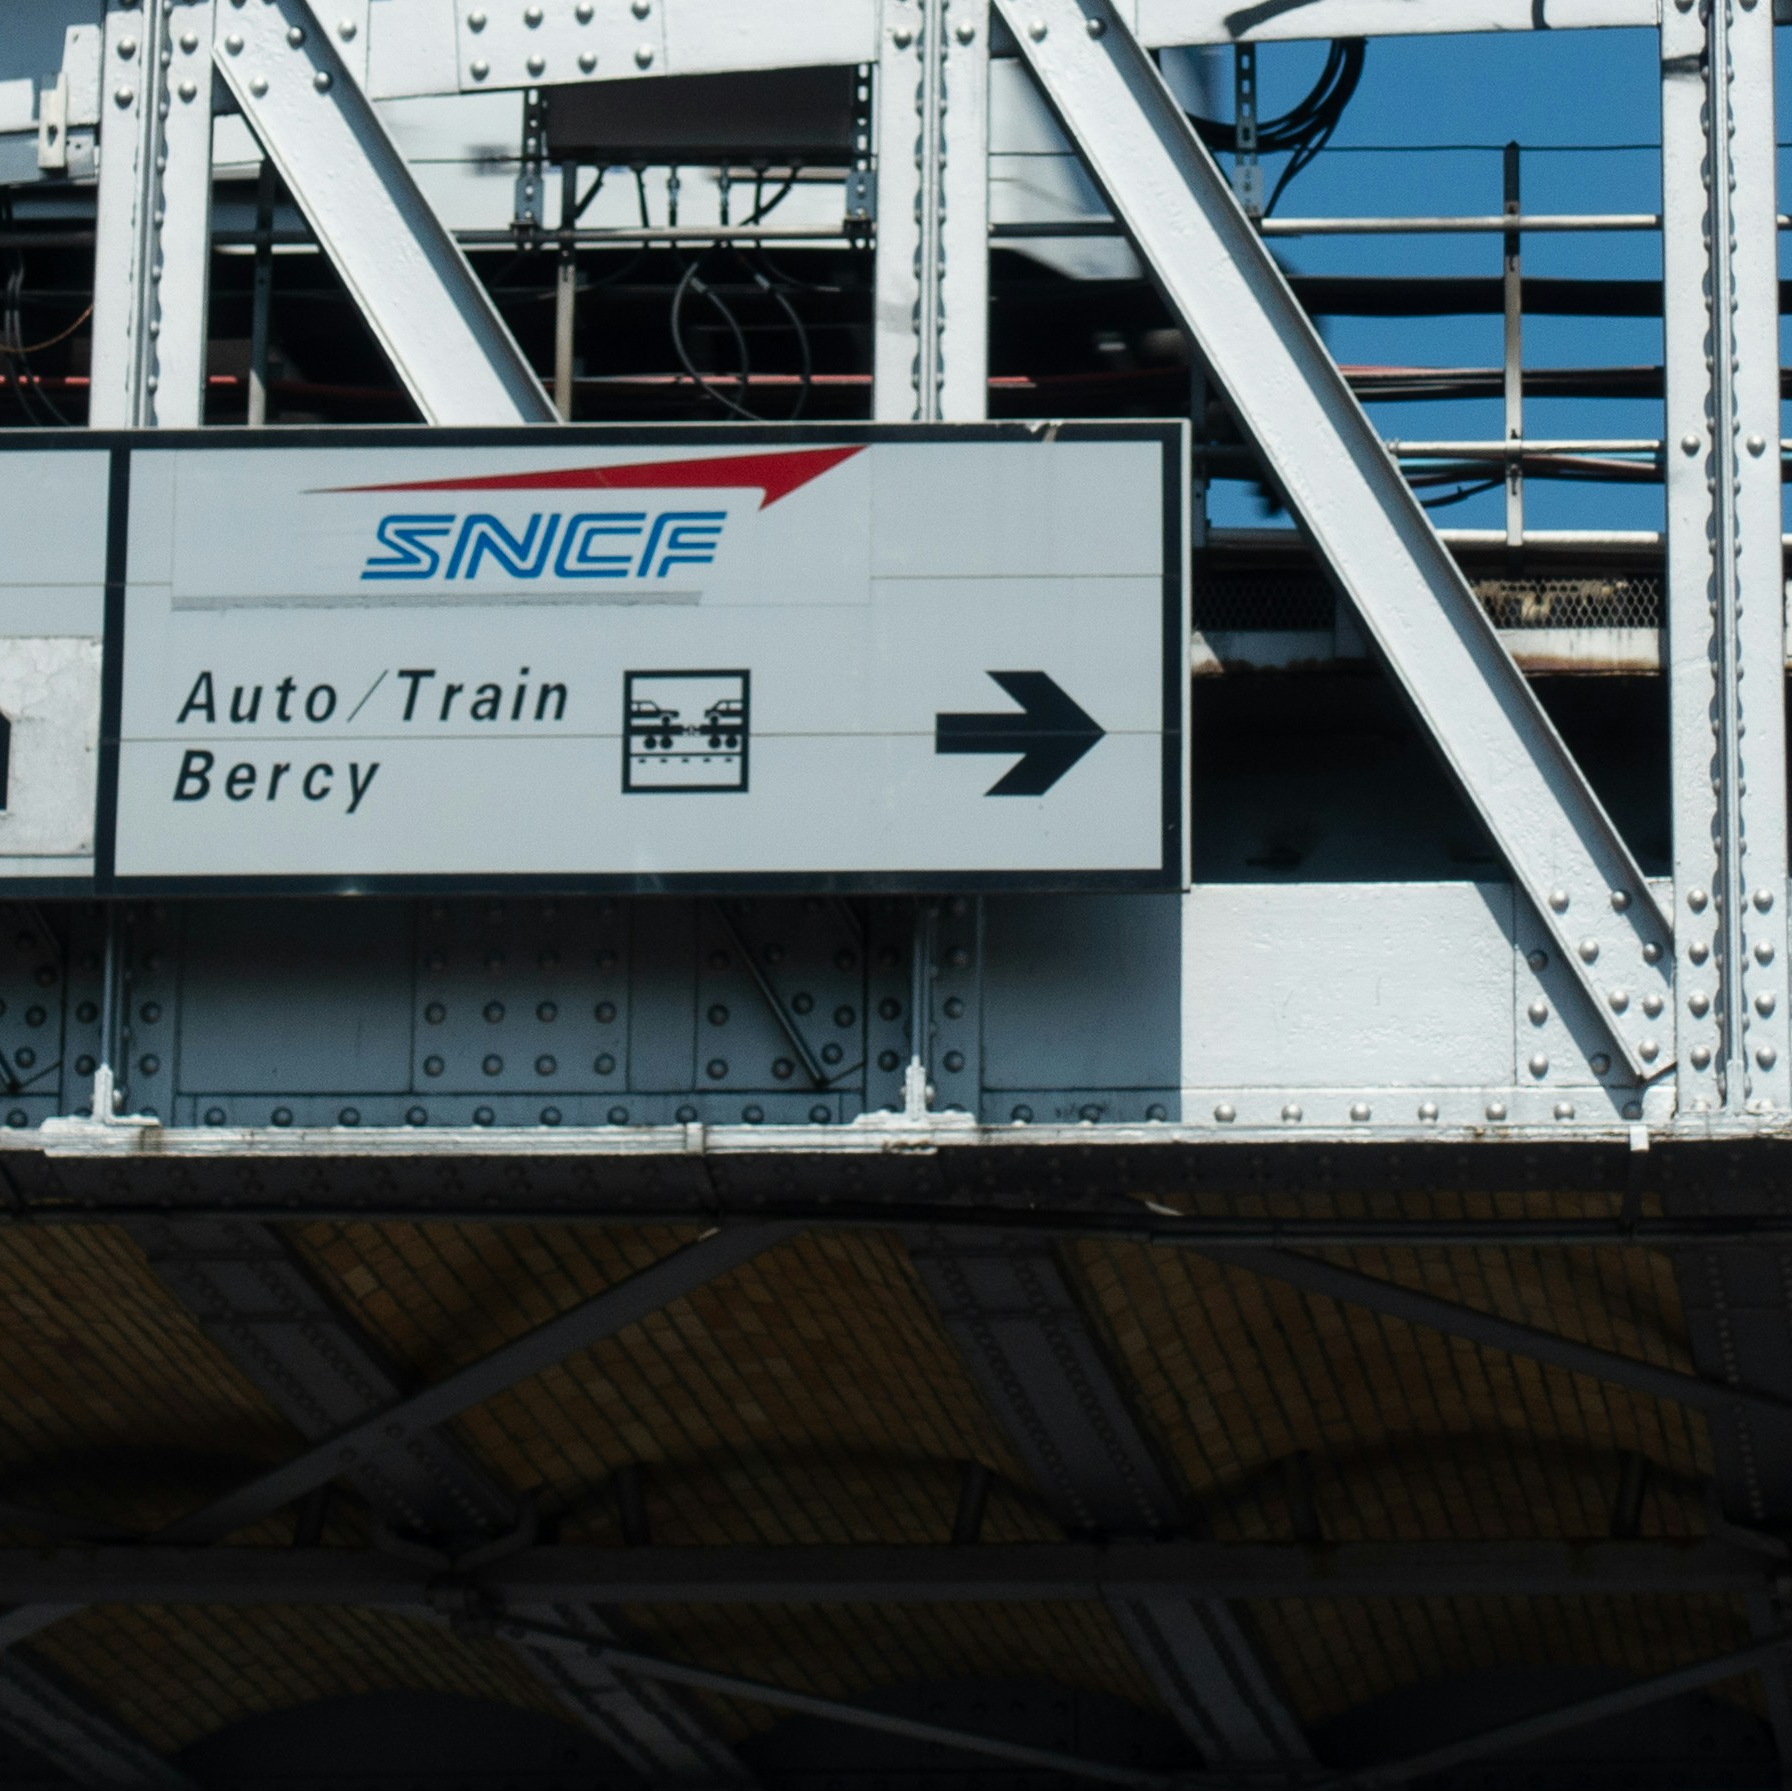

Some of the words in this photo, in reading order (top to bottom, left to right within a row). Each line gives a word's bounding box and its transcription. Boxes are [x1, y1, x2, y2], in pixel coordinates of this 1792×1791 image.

[361, 512, 727, 580] SNCF
[177, 670, 567, 723] Auto/Train
[174, 750, 379, 813] Bercy
